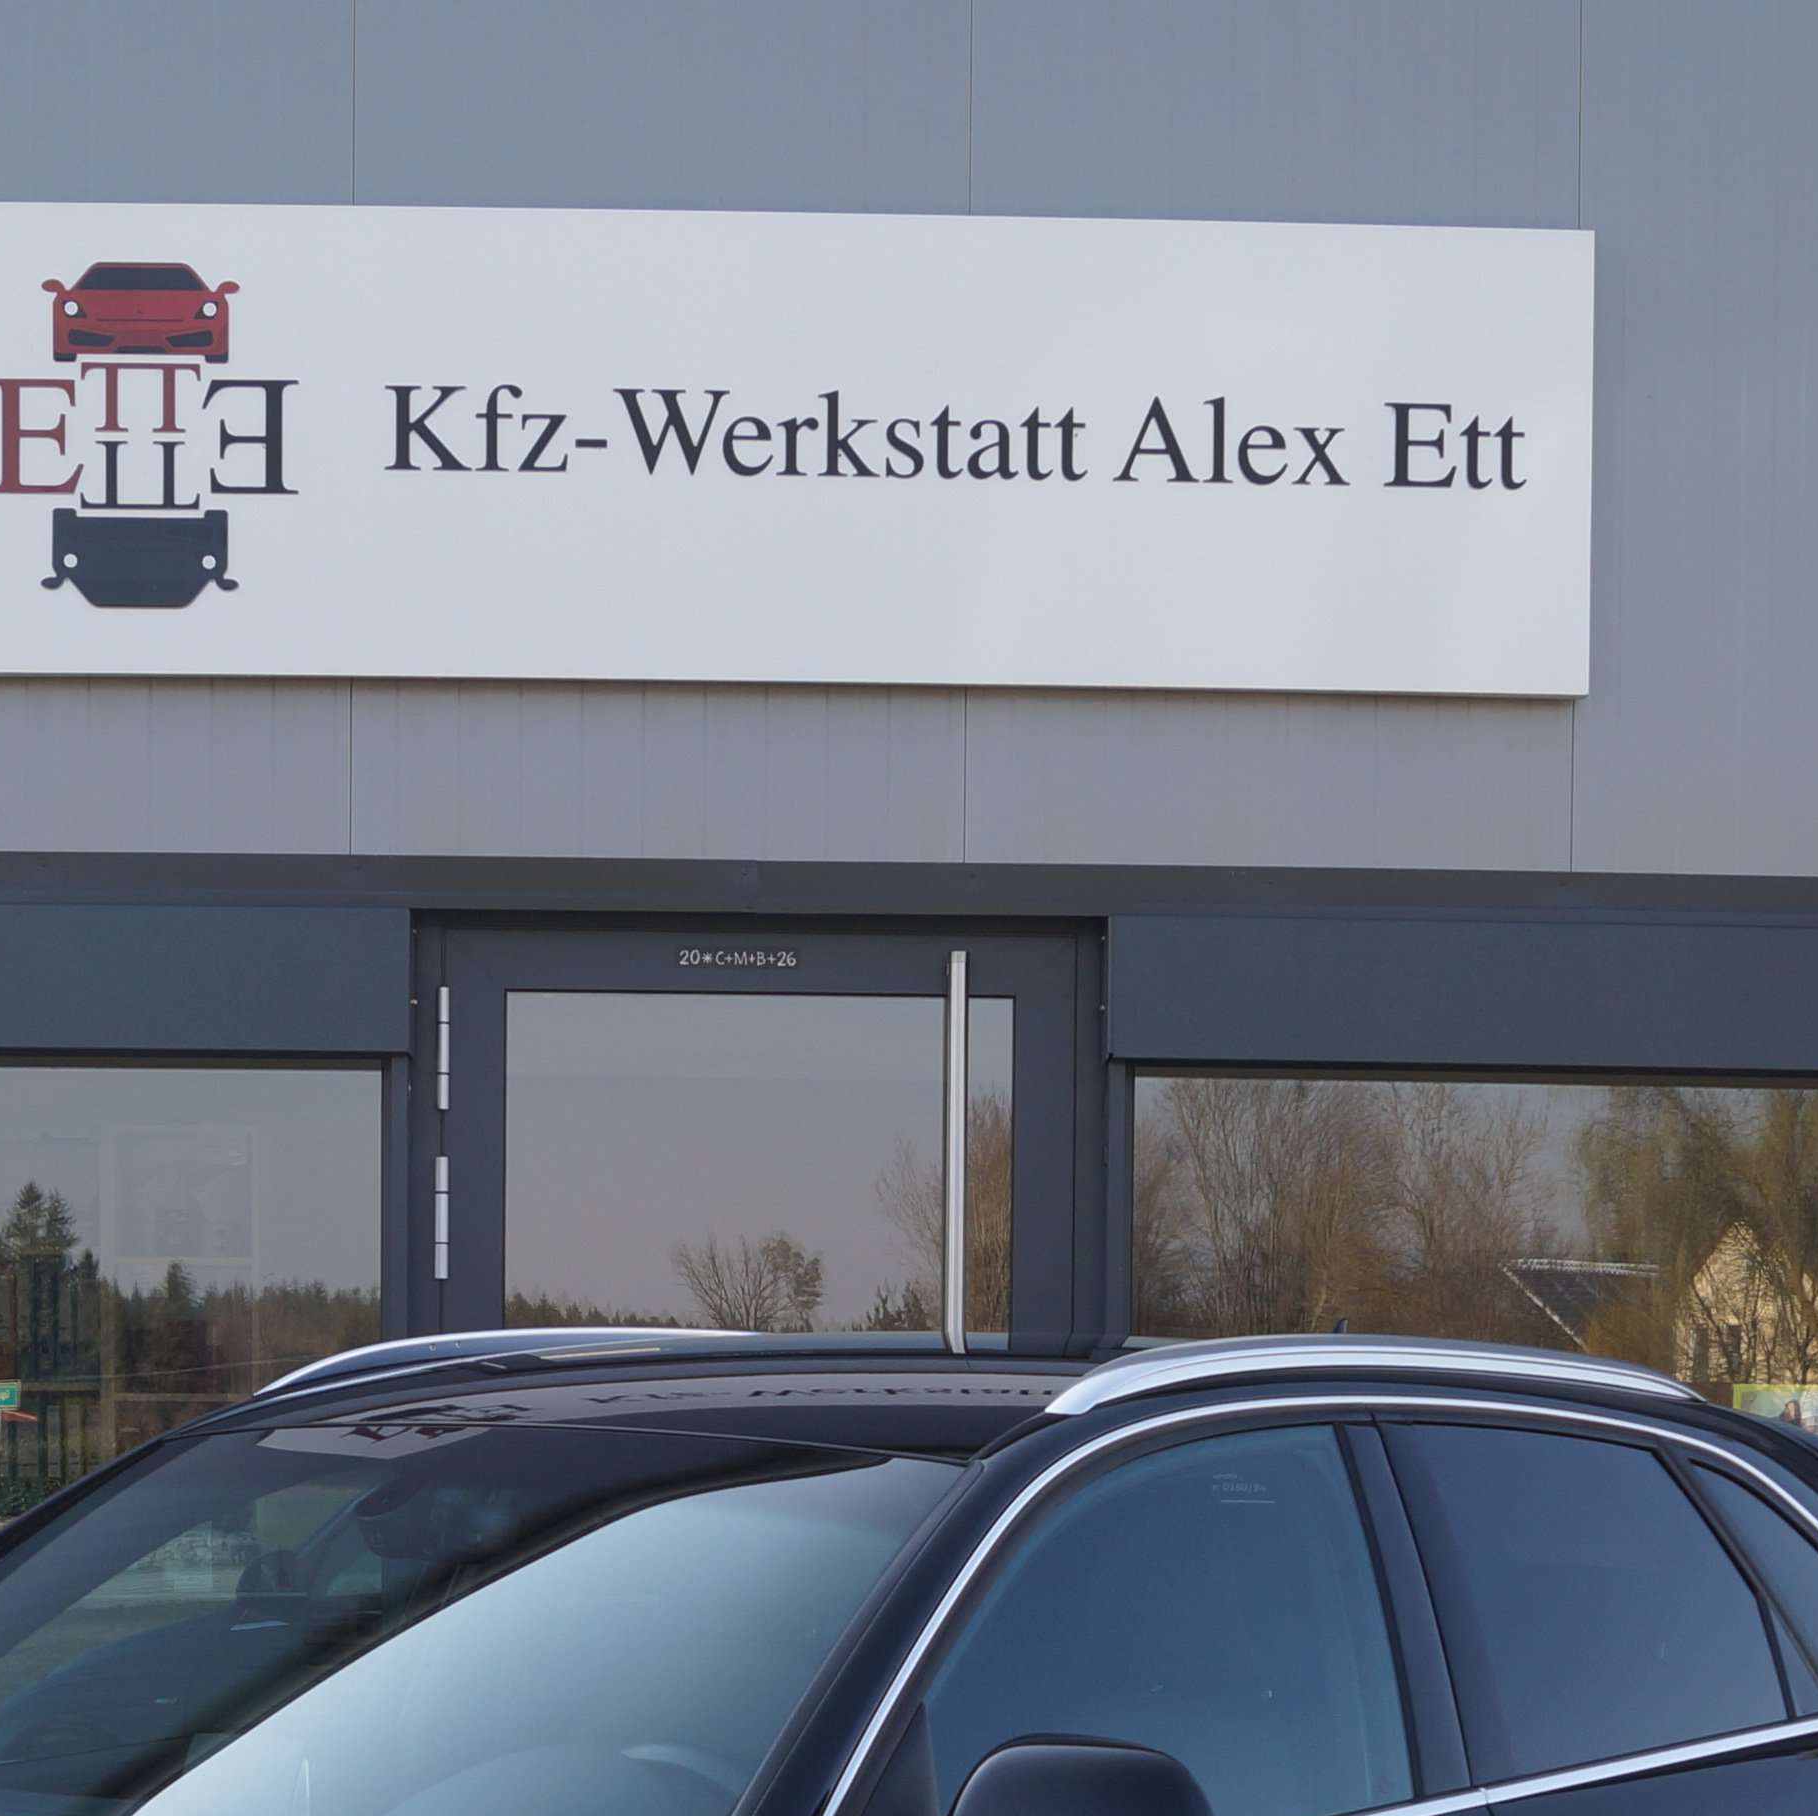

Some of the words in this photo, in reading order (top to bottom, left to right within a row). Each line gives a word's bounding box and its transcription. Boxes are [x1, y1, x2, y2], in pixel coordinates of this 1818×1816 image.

[383, 384, 1089, 482] Kfz-Werkstatt
[1112, 396, 1350, 485] Alex
[1383, 402, 1527, 490] Ett
